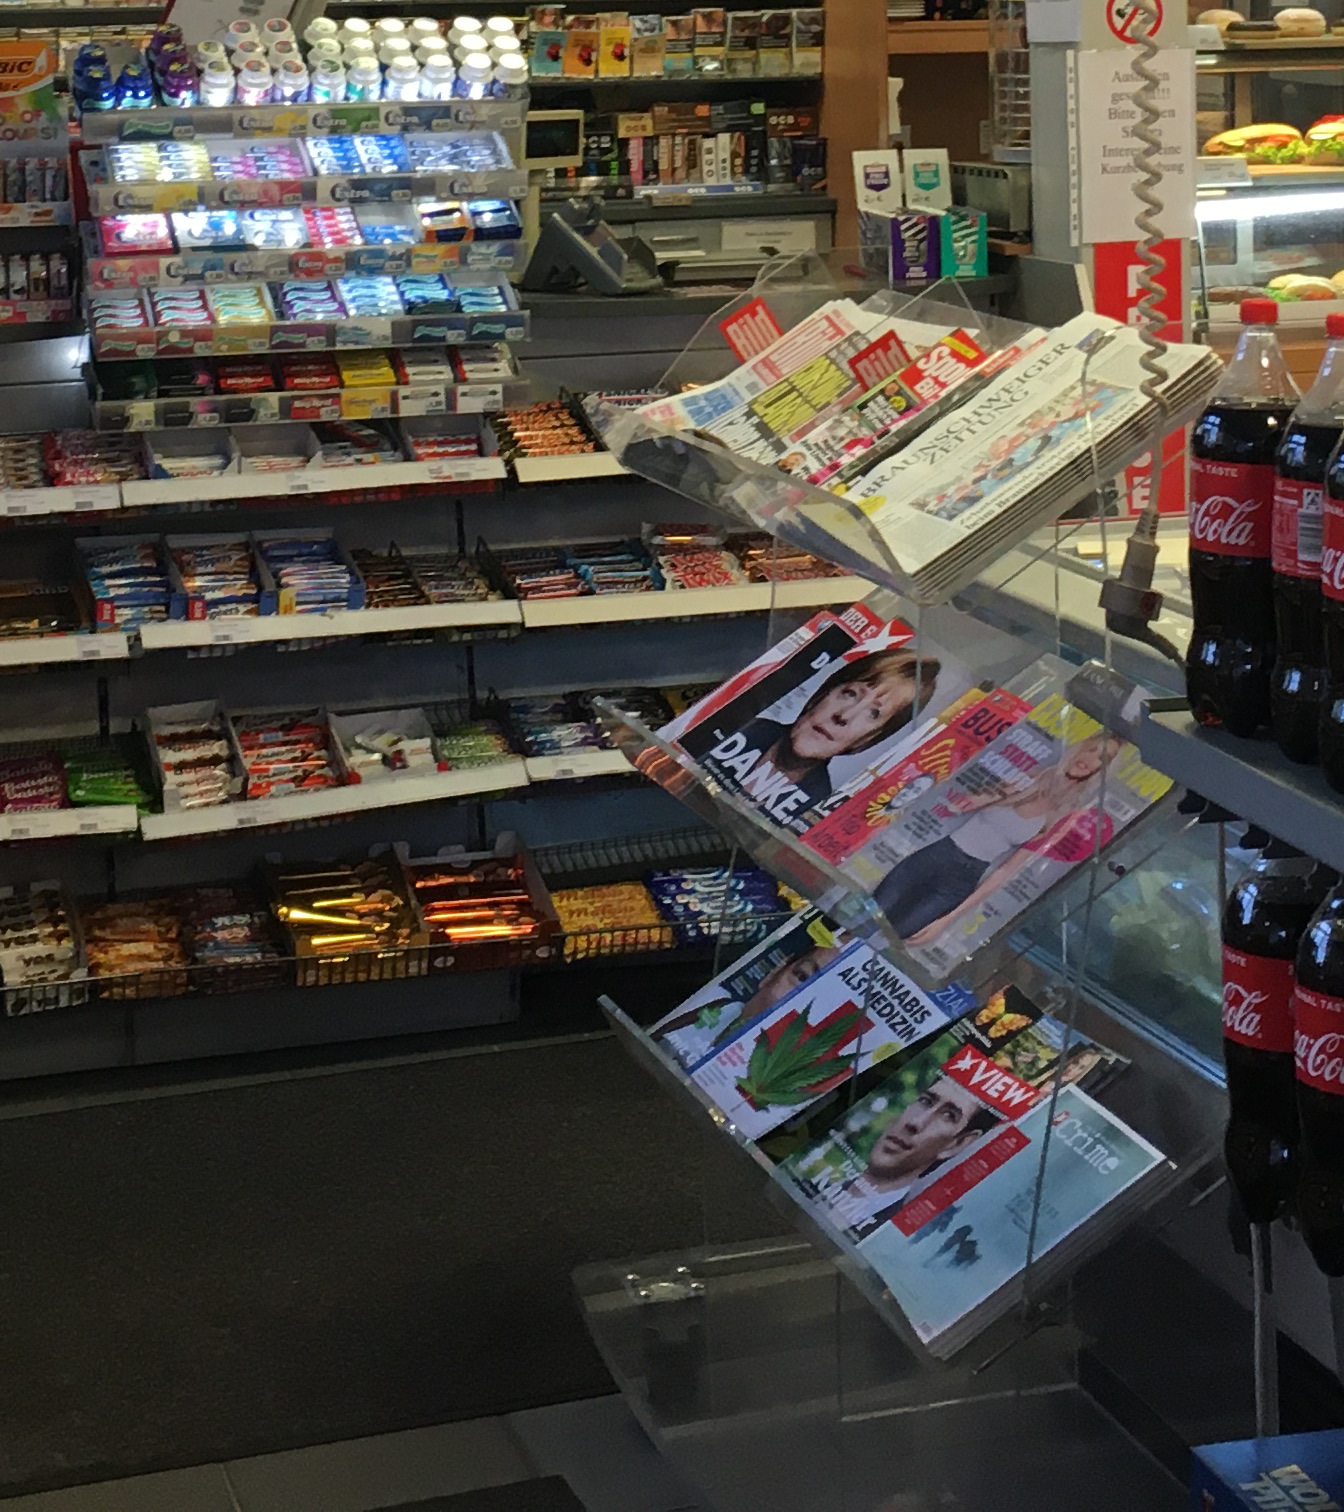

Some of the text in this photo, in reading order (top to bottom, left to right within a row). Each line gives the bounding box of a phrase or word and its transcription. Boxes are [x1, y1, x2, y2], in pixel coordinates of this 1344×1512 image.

[1108, 108, 1137, 121] Bitte
[726, 305, 779, 362] Bild
[860, 342, 1072, 498] BRAUNSCHWEIGER
[927, 389, 1030, 465] ZEITUNG
[1207, 464, 1239, 478] TASTE
[862, 957, 933, 1025] CANNABIS
[863, 988, 922, 1040] MEDIZIN
[969, 1059, 1036, 1109] VIEW
[1057, 1118, 1124, 1175] Crime
